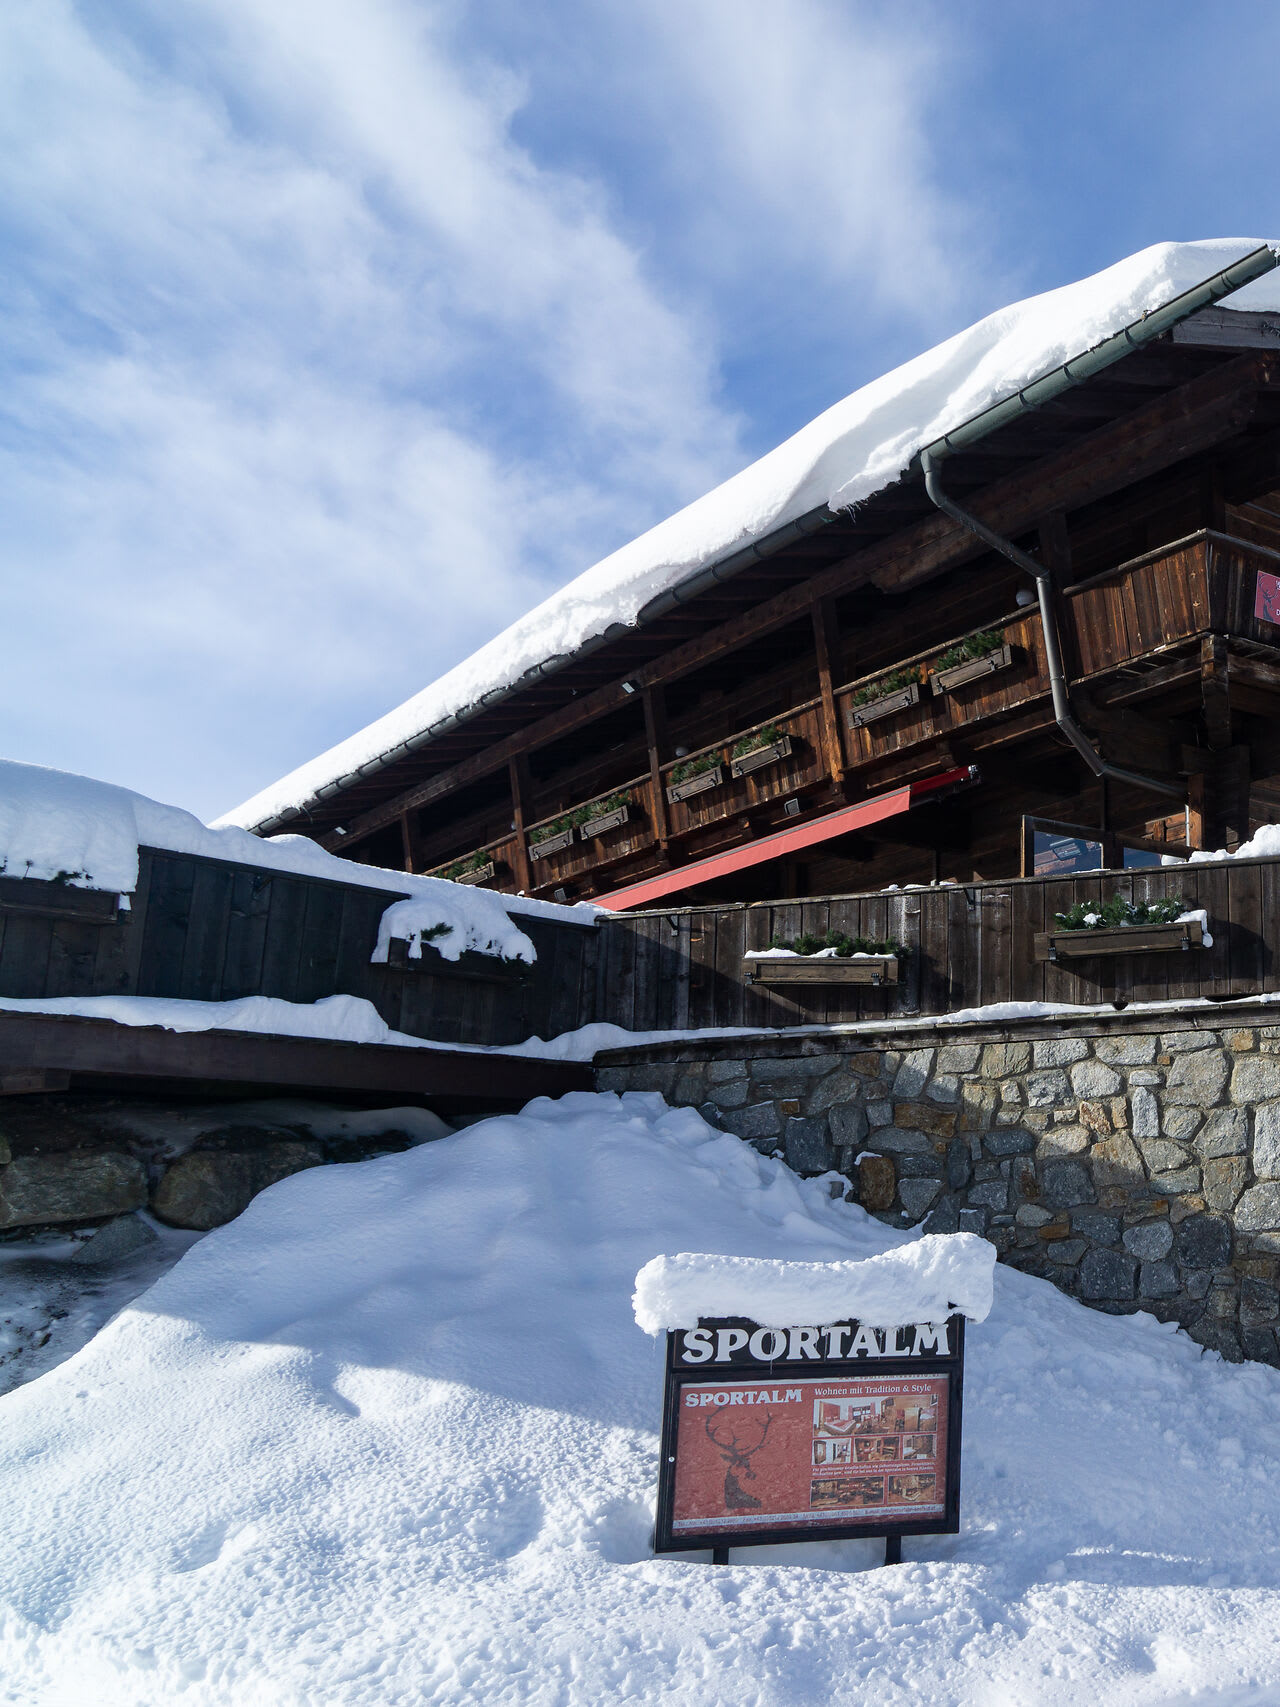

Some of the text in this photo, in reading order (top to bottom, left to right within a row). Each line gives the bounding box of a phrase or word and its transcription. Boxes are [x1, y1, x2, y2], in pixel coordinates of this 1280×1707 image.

[681, 1324, 951, 1363] SPORTALM
[684, 1388, 803, 1408] SPORTALM
[814, 1383, 932, 1396] Wohnen mit Tradition & Style
